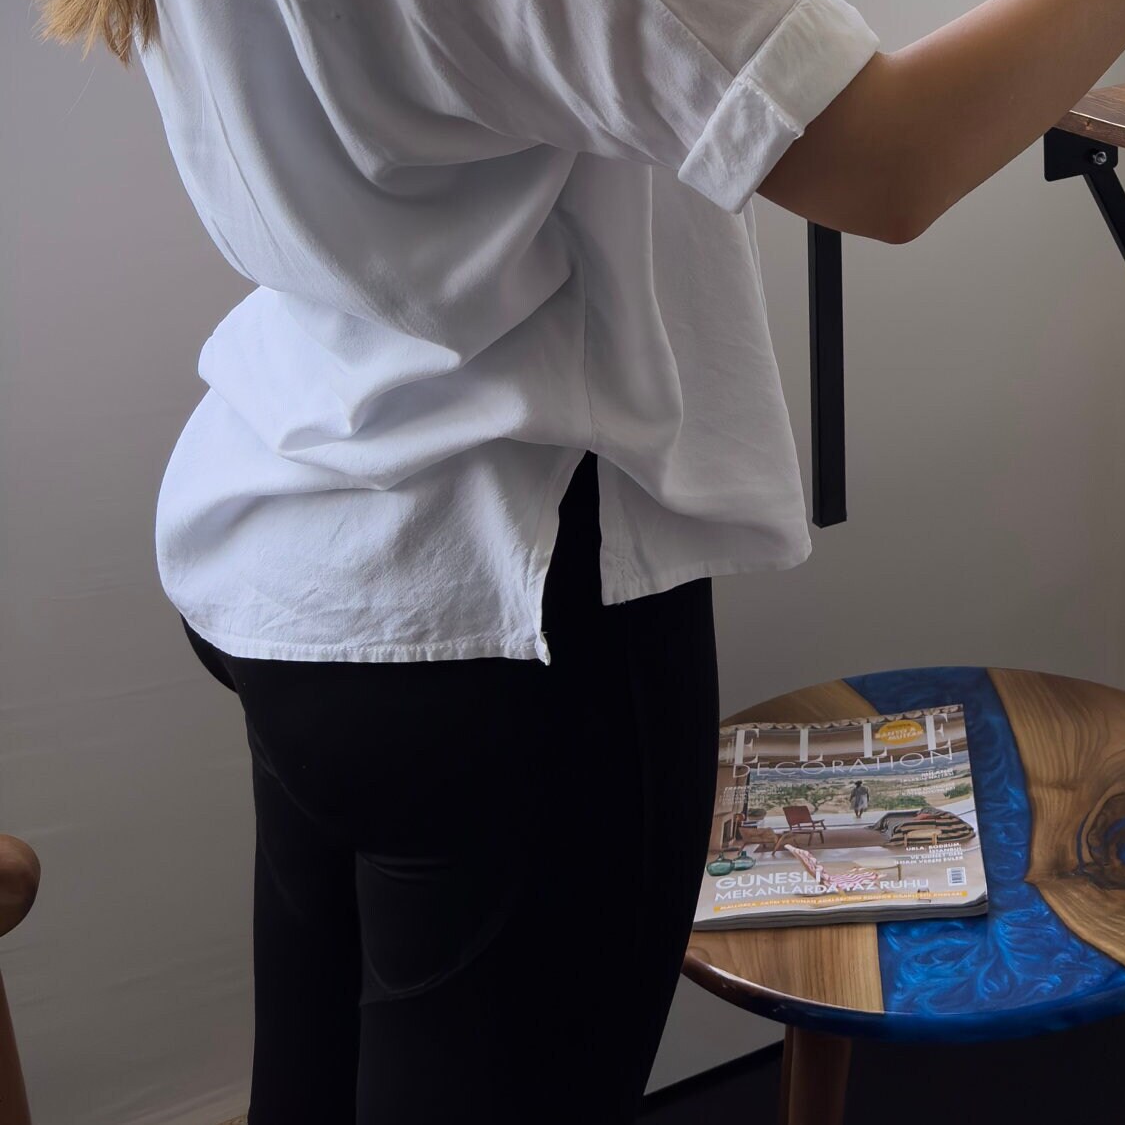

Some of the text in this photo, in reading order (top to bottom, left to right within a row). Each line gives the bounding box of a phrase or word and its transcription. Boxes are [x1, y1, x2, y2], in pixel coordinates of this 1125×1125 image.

[733, 713, 951, 764] ELLE
[732, 746, 953, 778] DECORATION
[715, 865, 822, 889] GÜNEŞLİ
[715, 882, 839, 901] MEKANLARDA
[843, 880, 877, 891] YAZ
[880, 879, 929, 889] RUHU
